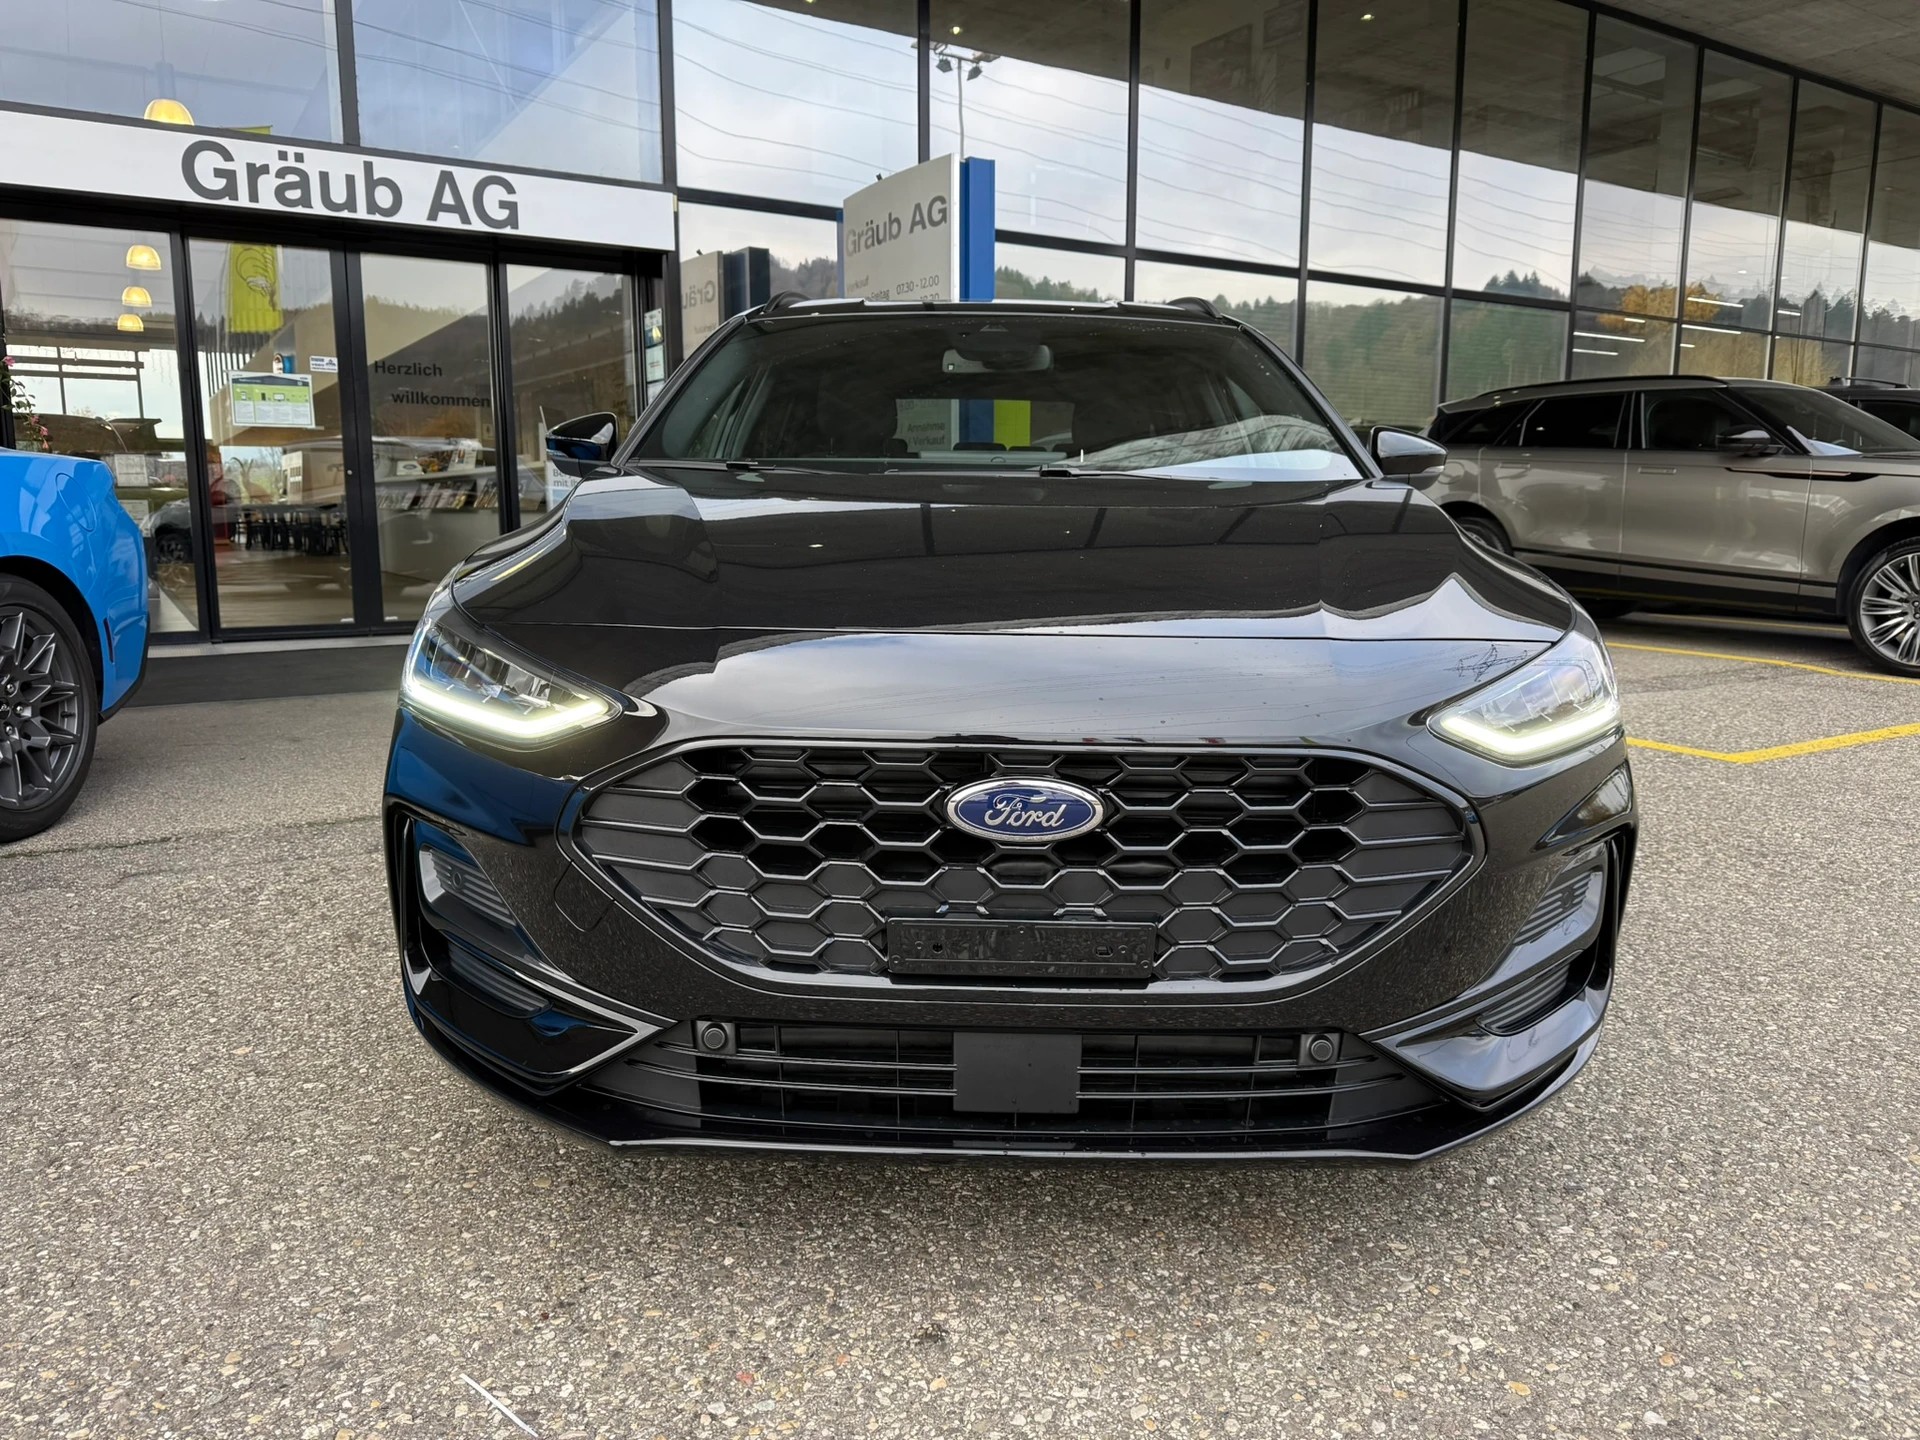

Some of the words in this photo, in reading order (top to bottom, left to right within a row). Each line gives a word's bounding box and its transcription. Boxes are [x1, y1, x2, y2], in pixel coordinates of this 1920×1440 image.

[181, 140, 403, 218] Gräub
[426, 169, 520, 230] AG
[846, 211, 901, 257] Gräub
[908, 195, 948, 234] AG
[920, 274, 940, 289] 12.00
[374, 361, 443, 377] Herzlich
[391, 391, 491, 408] willkommen
[984, 793, 1068, 828] Ford
